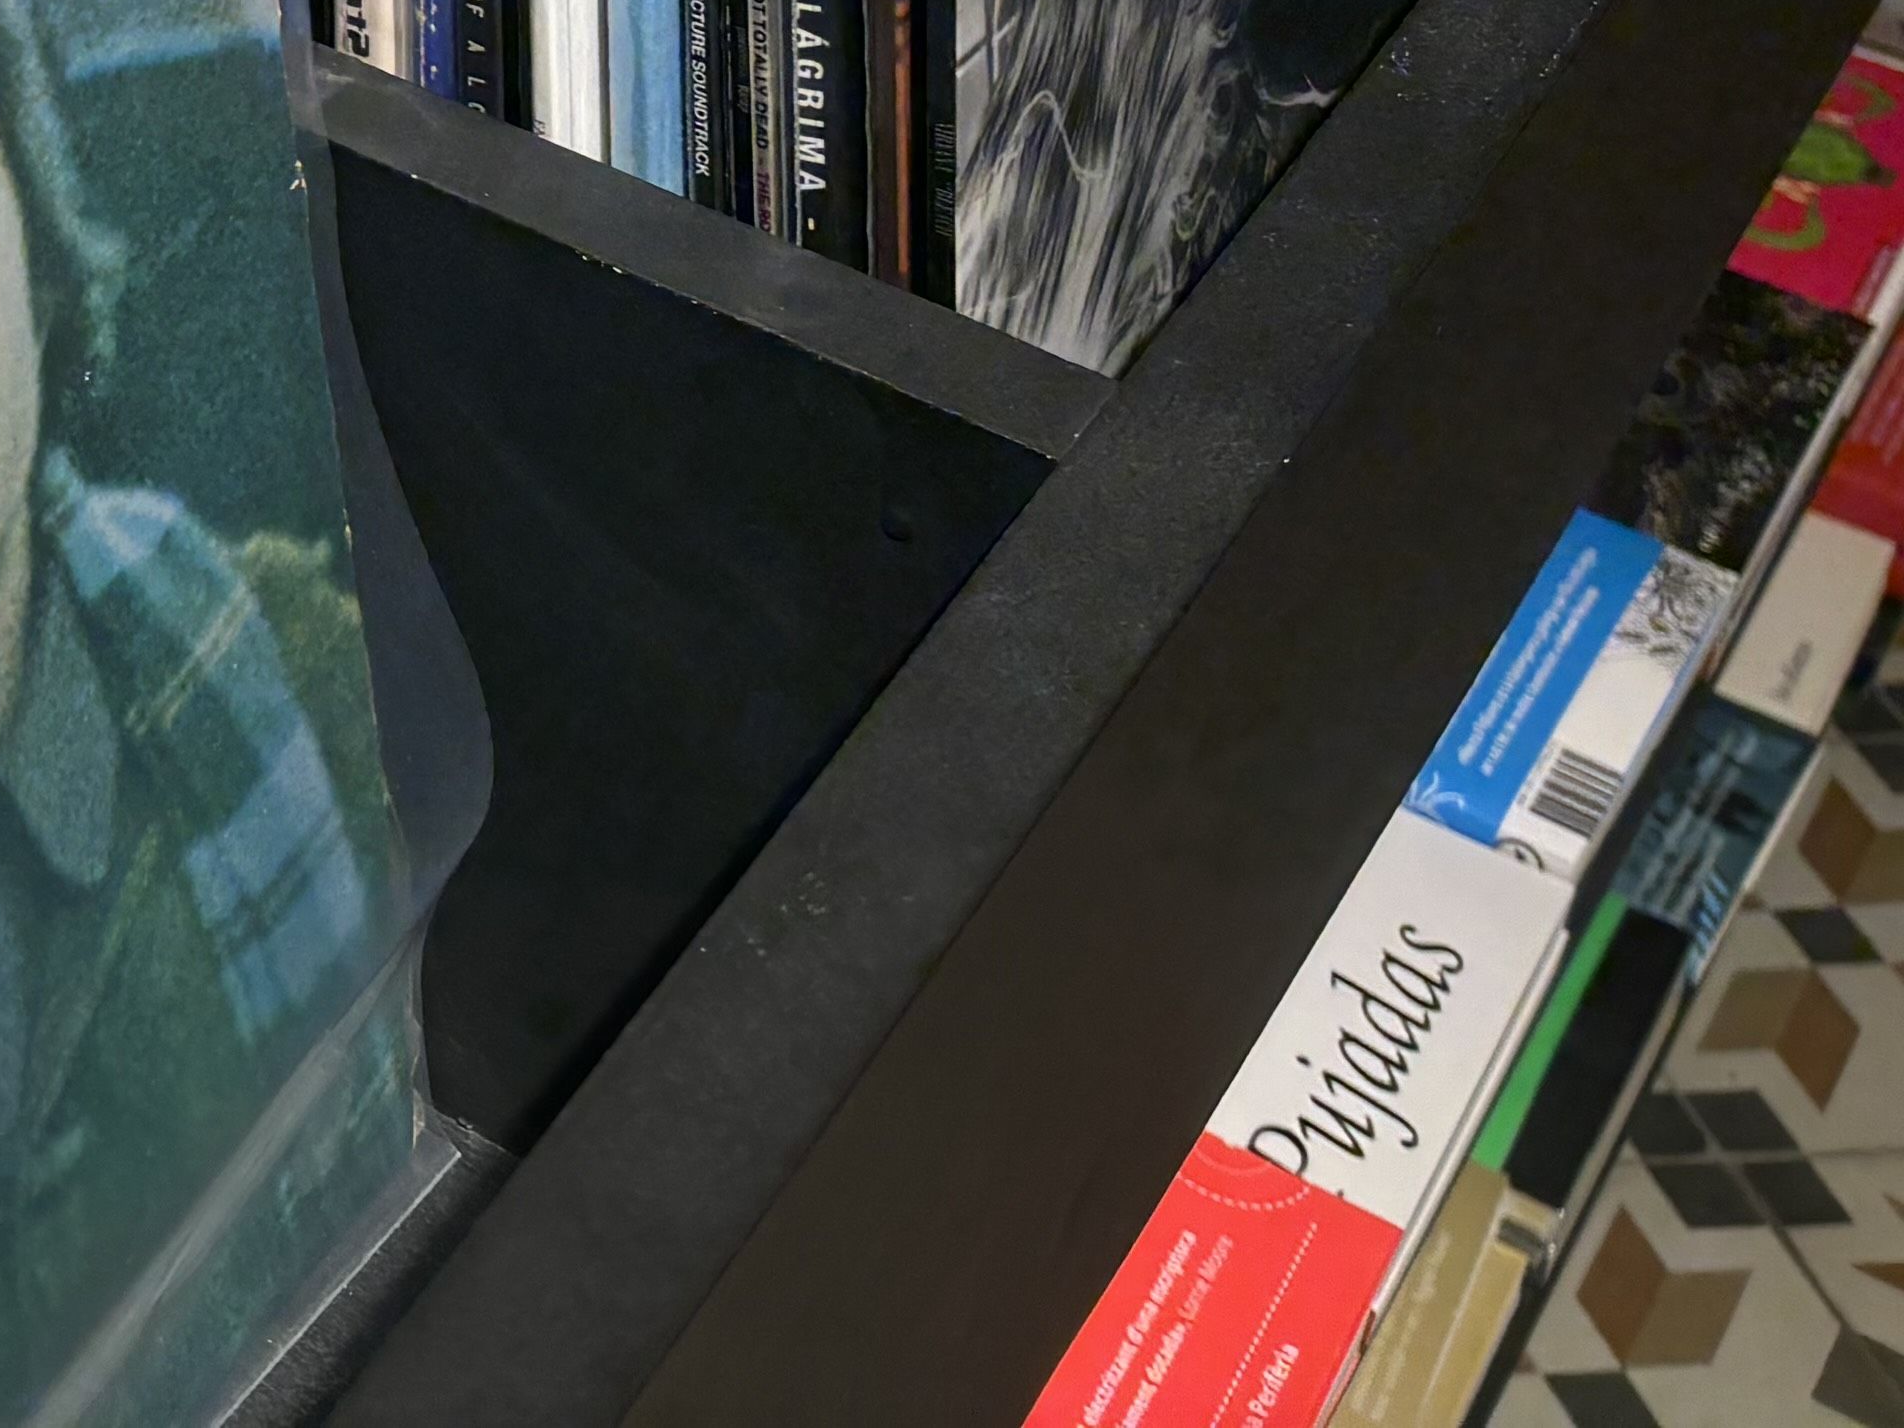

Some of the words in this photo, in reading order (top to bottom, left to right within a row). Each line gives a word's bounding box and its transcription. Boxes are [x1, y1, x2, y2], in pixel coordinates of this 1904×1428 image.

[466, 39, 486, 53] A
[753, 19, 769, 97] TOTALLY
[690, 59, 710, 177] SOUNDTRACK
[754, 100, 769, 149] DEAD
[793, 2, 831, 192] LÁGRIMA
[1247, 922, 1465, 1179] Pujadas
